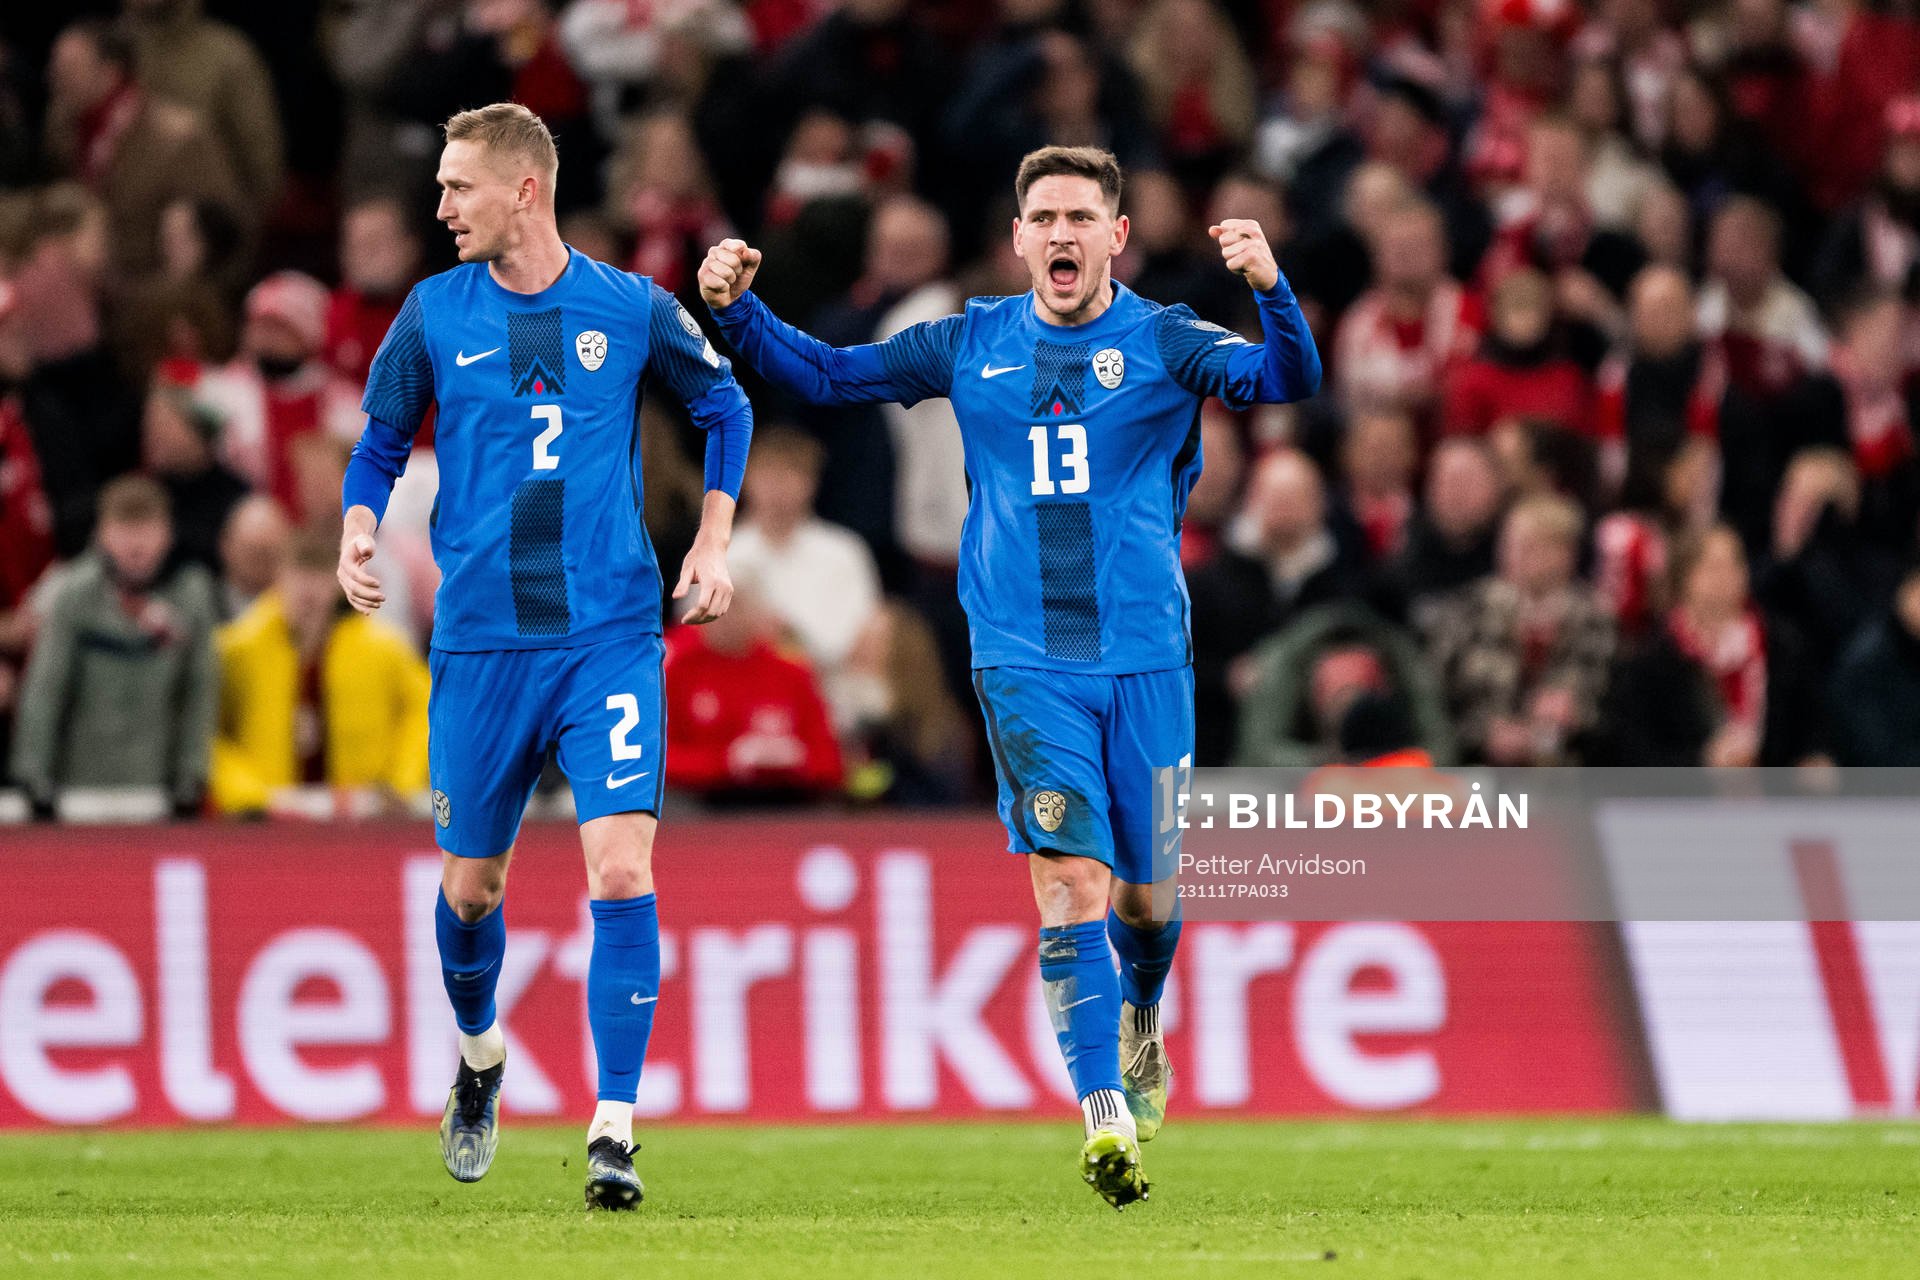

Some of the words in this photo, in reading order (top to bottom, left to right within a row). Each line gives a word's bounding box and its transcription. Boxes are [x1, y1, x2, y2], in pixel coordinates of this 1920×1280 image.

[530, 404, 563, 470] 2
[1027, 424, 1090, 496] 13
[606, 693, 642, 762] 2
[0, 848, 1447, 1123] elekrikre
